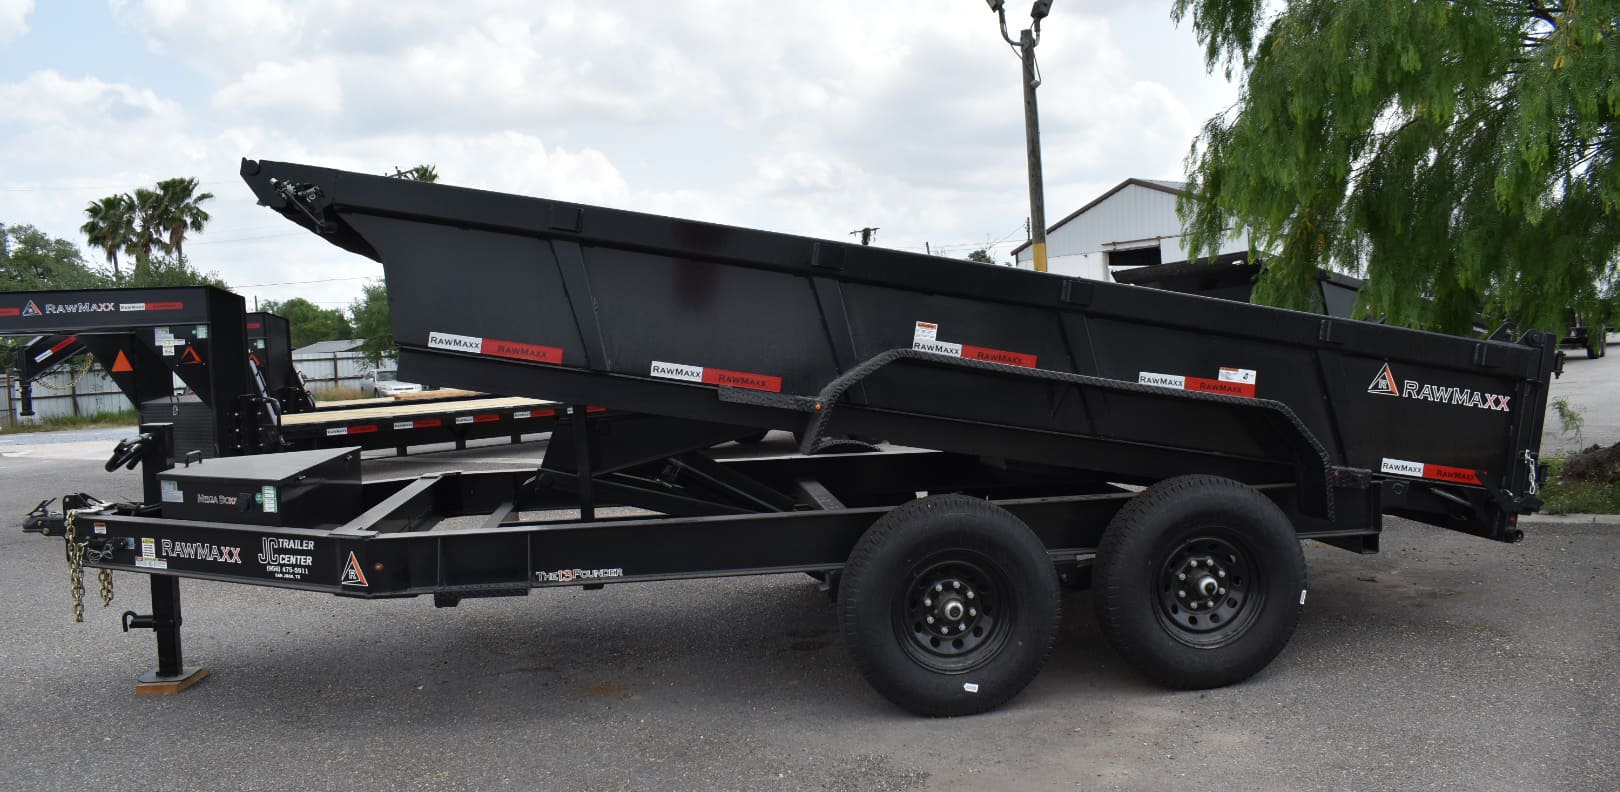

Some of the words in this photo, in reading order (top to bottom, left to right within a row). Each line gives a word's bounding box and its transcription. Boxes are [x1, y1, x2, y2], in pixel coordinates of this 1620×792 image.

[45, 302, 115, 314] RAWMAXX
[430, 336, 480, 349] RAWMAXX
[913, 342, 960, 355] RAWMAXX
[497, 344, 548, 358] RAWMAXX
[977, 351, 1023, 363] RAWMAXX
[652, 365, 702, 378] RAWMAXX
[718, 374, 767, 387] RAWMAXX
[1140, 375, 1184, 387] RAWMAXX
[1200, 382, 1242, 393] RAWMAXX
[1403, 380, 1511, 411] RAWMAXX
[1382, 462, 1422, 474] RAWMAXX
[278, 538, 315, 550] TRAILER
[161, 539, 242, 564] RAWMAXX
[258, 537, 280, 565] JC
[279, 554, 313, 566] CENTER
